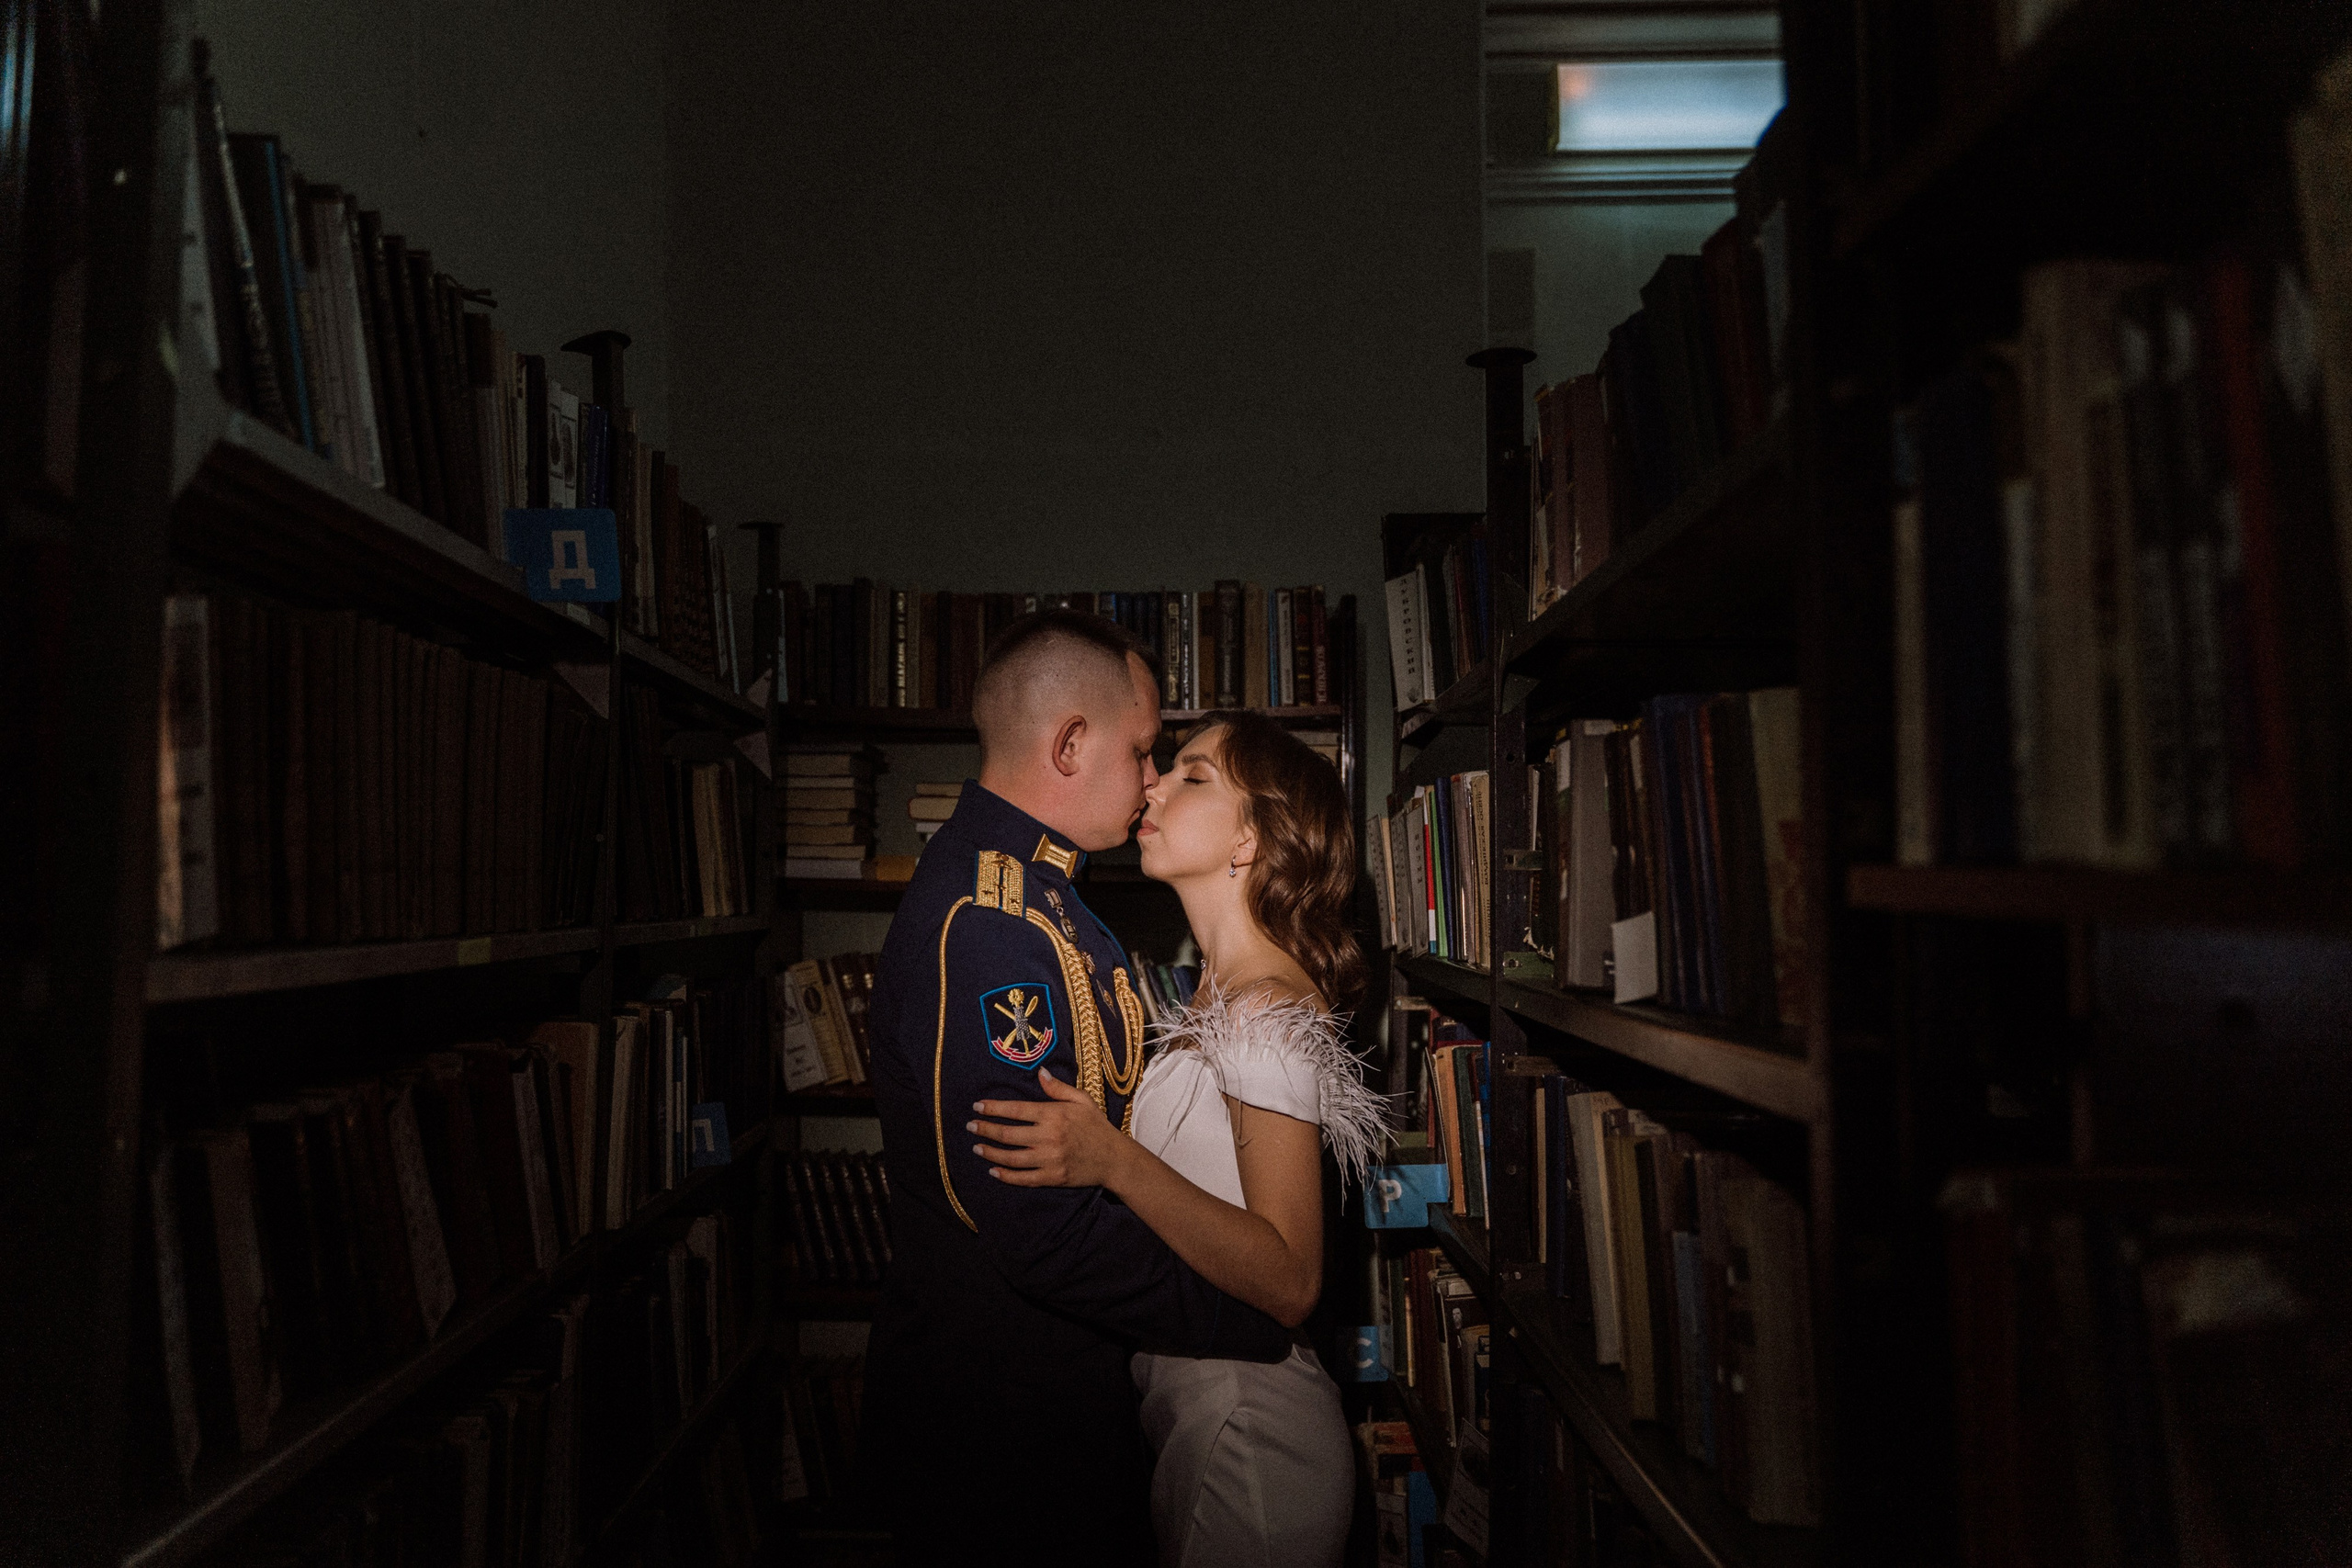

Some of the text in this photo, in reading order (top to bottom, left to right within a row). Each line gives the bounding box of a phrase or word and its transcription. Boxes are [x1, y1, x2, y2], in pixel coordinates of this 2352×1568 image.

[548, 530, 596, 590] Д
[1378, 1179, 1403, 1213] Р
[1347, 1337, 1374, 1369] С
